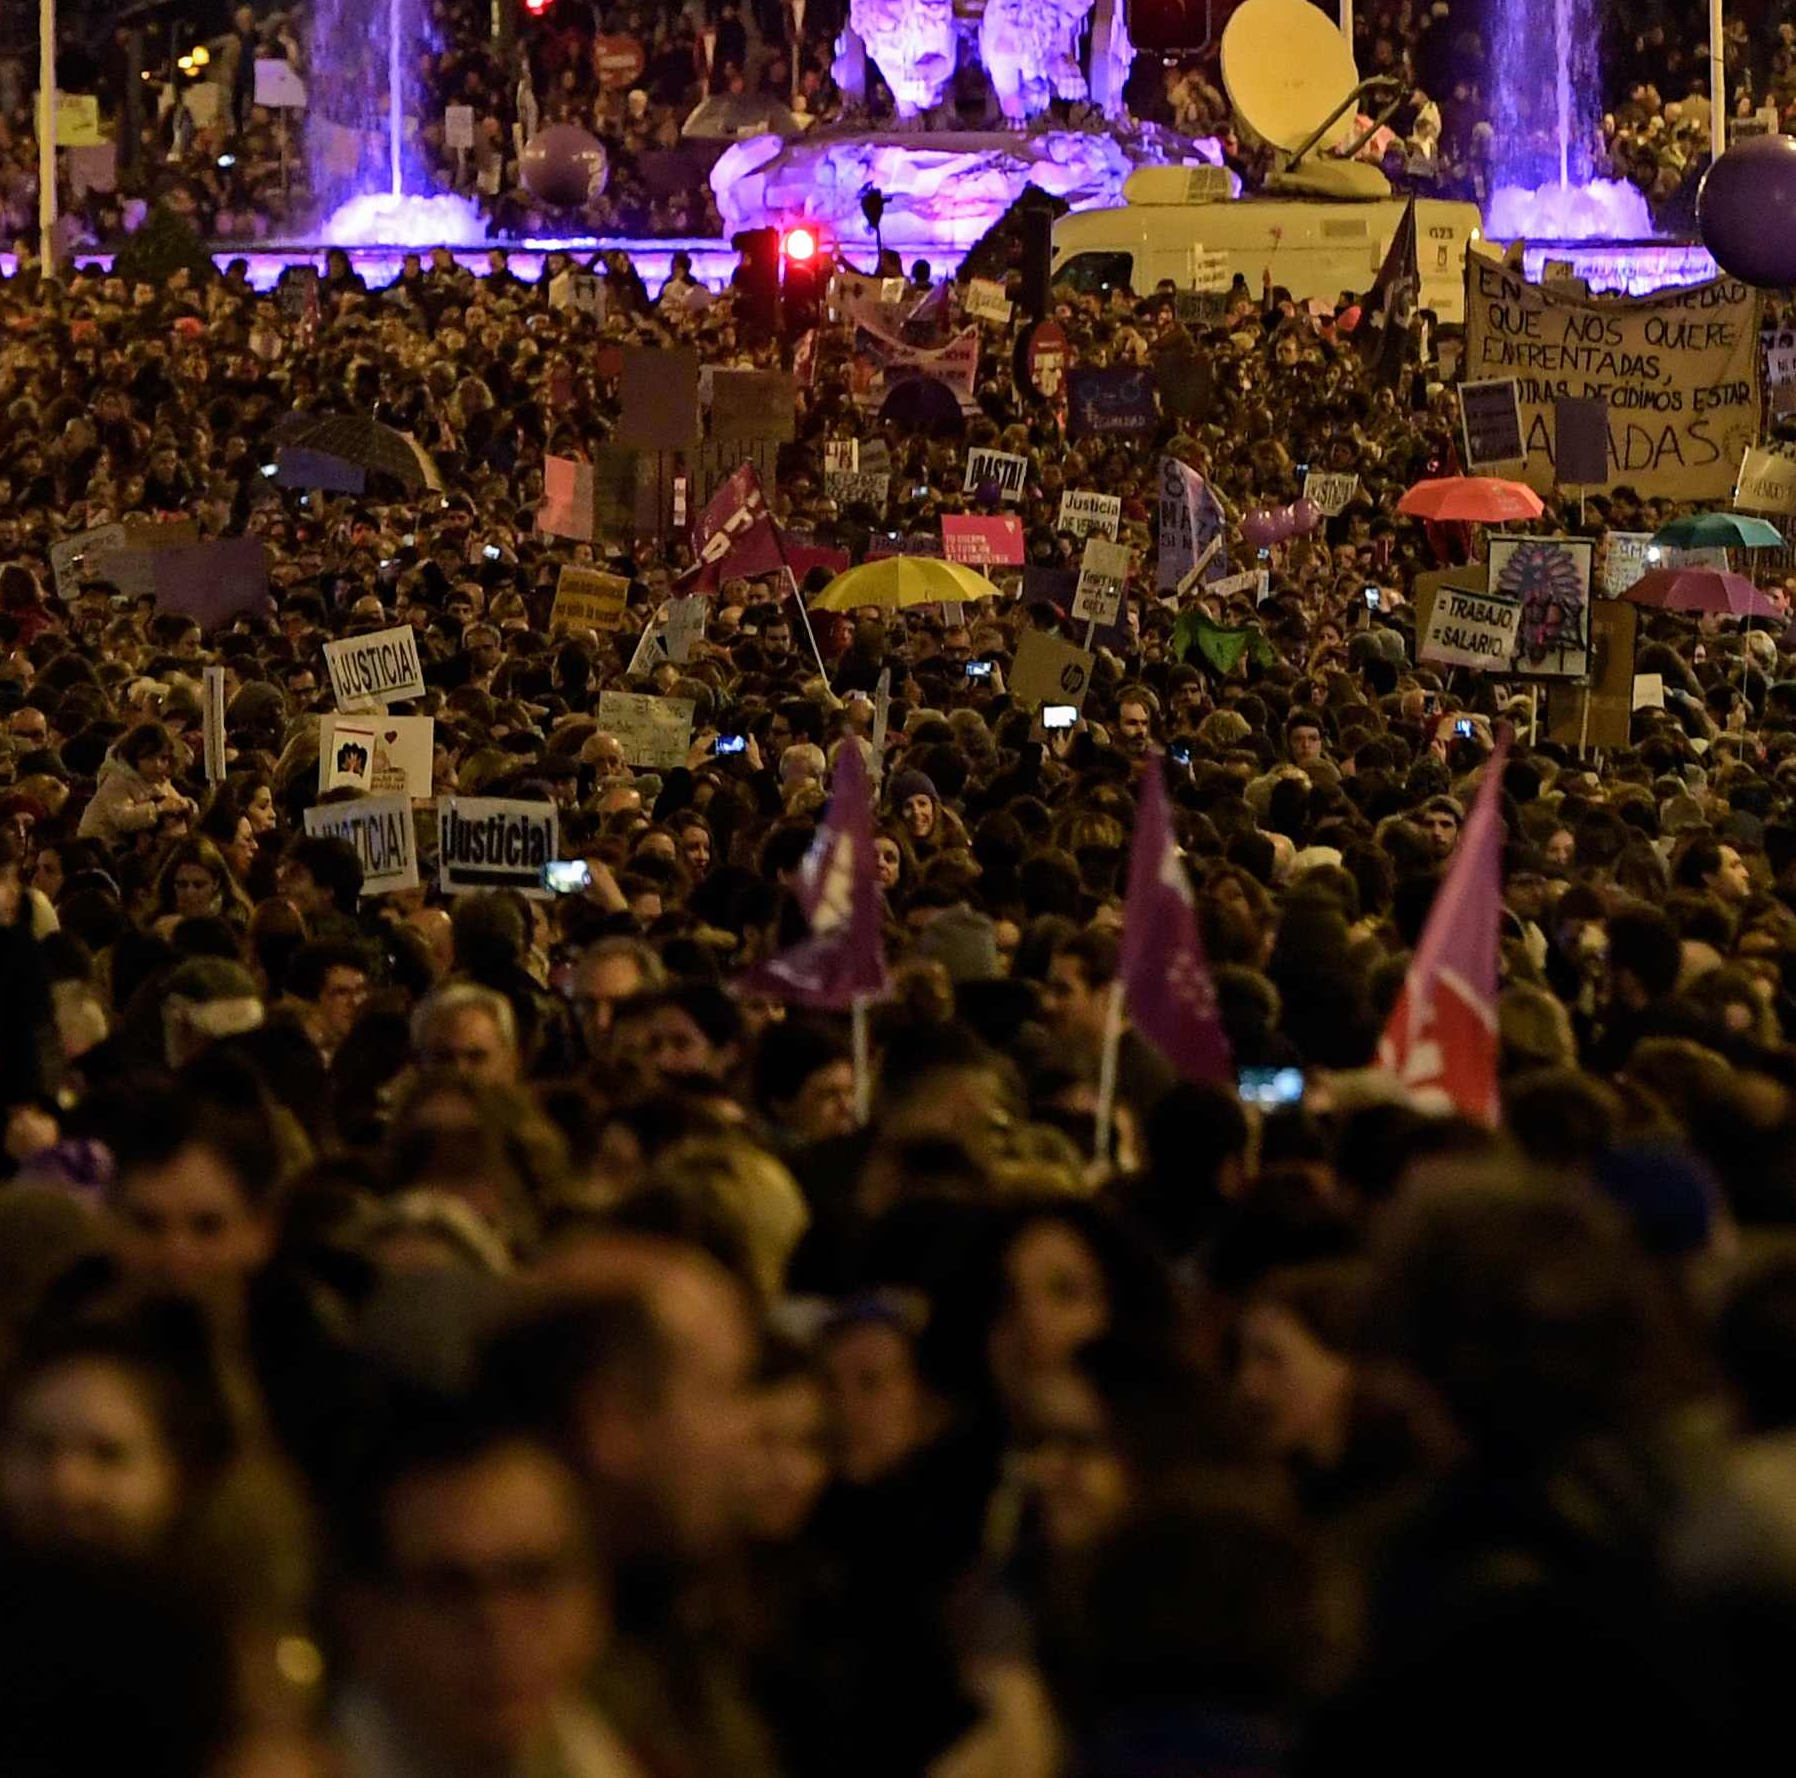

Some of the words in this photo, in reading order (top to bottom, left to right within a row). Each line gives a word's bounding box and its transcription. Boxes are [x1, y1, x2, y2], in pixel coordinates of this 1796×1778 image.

[1479, 265, 1521, 300] EN
[1488, 303, 1542, 339] QUE
[1564, 315, 1624, 346] NOS
[1644, 317, 1736, 351] QUIERE
[1483, 335, 1673, 386] ENFRENTADAS,
[1693, 383, 1751, 412] ESTAR
[1065, 494, 1118, 516] Justicia
[1448, 596, 1514, 633] TRABAJO,
[331, 638, 418, 697] ¡JUSTICIA!
